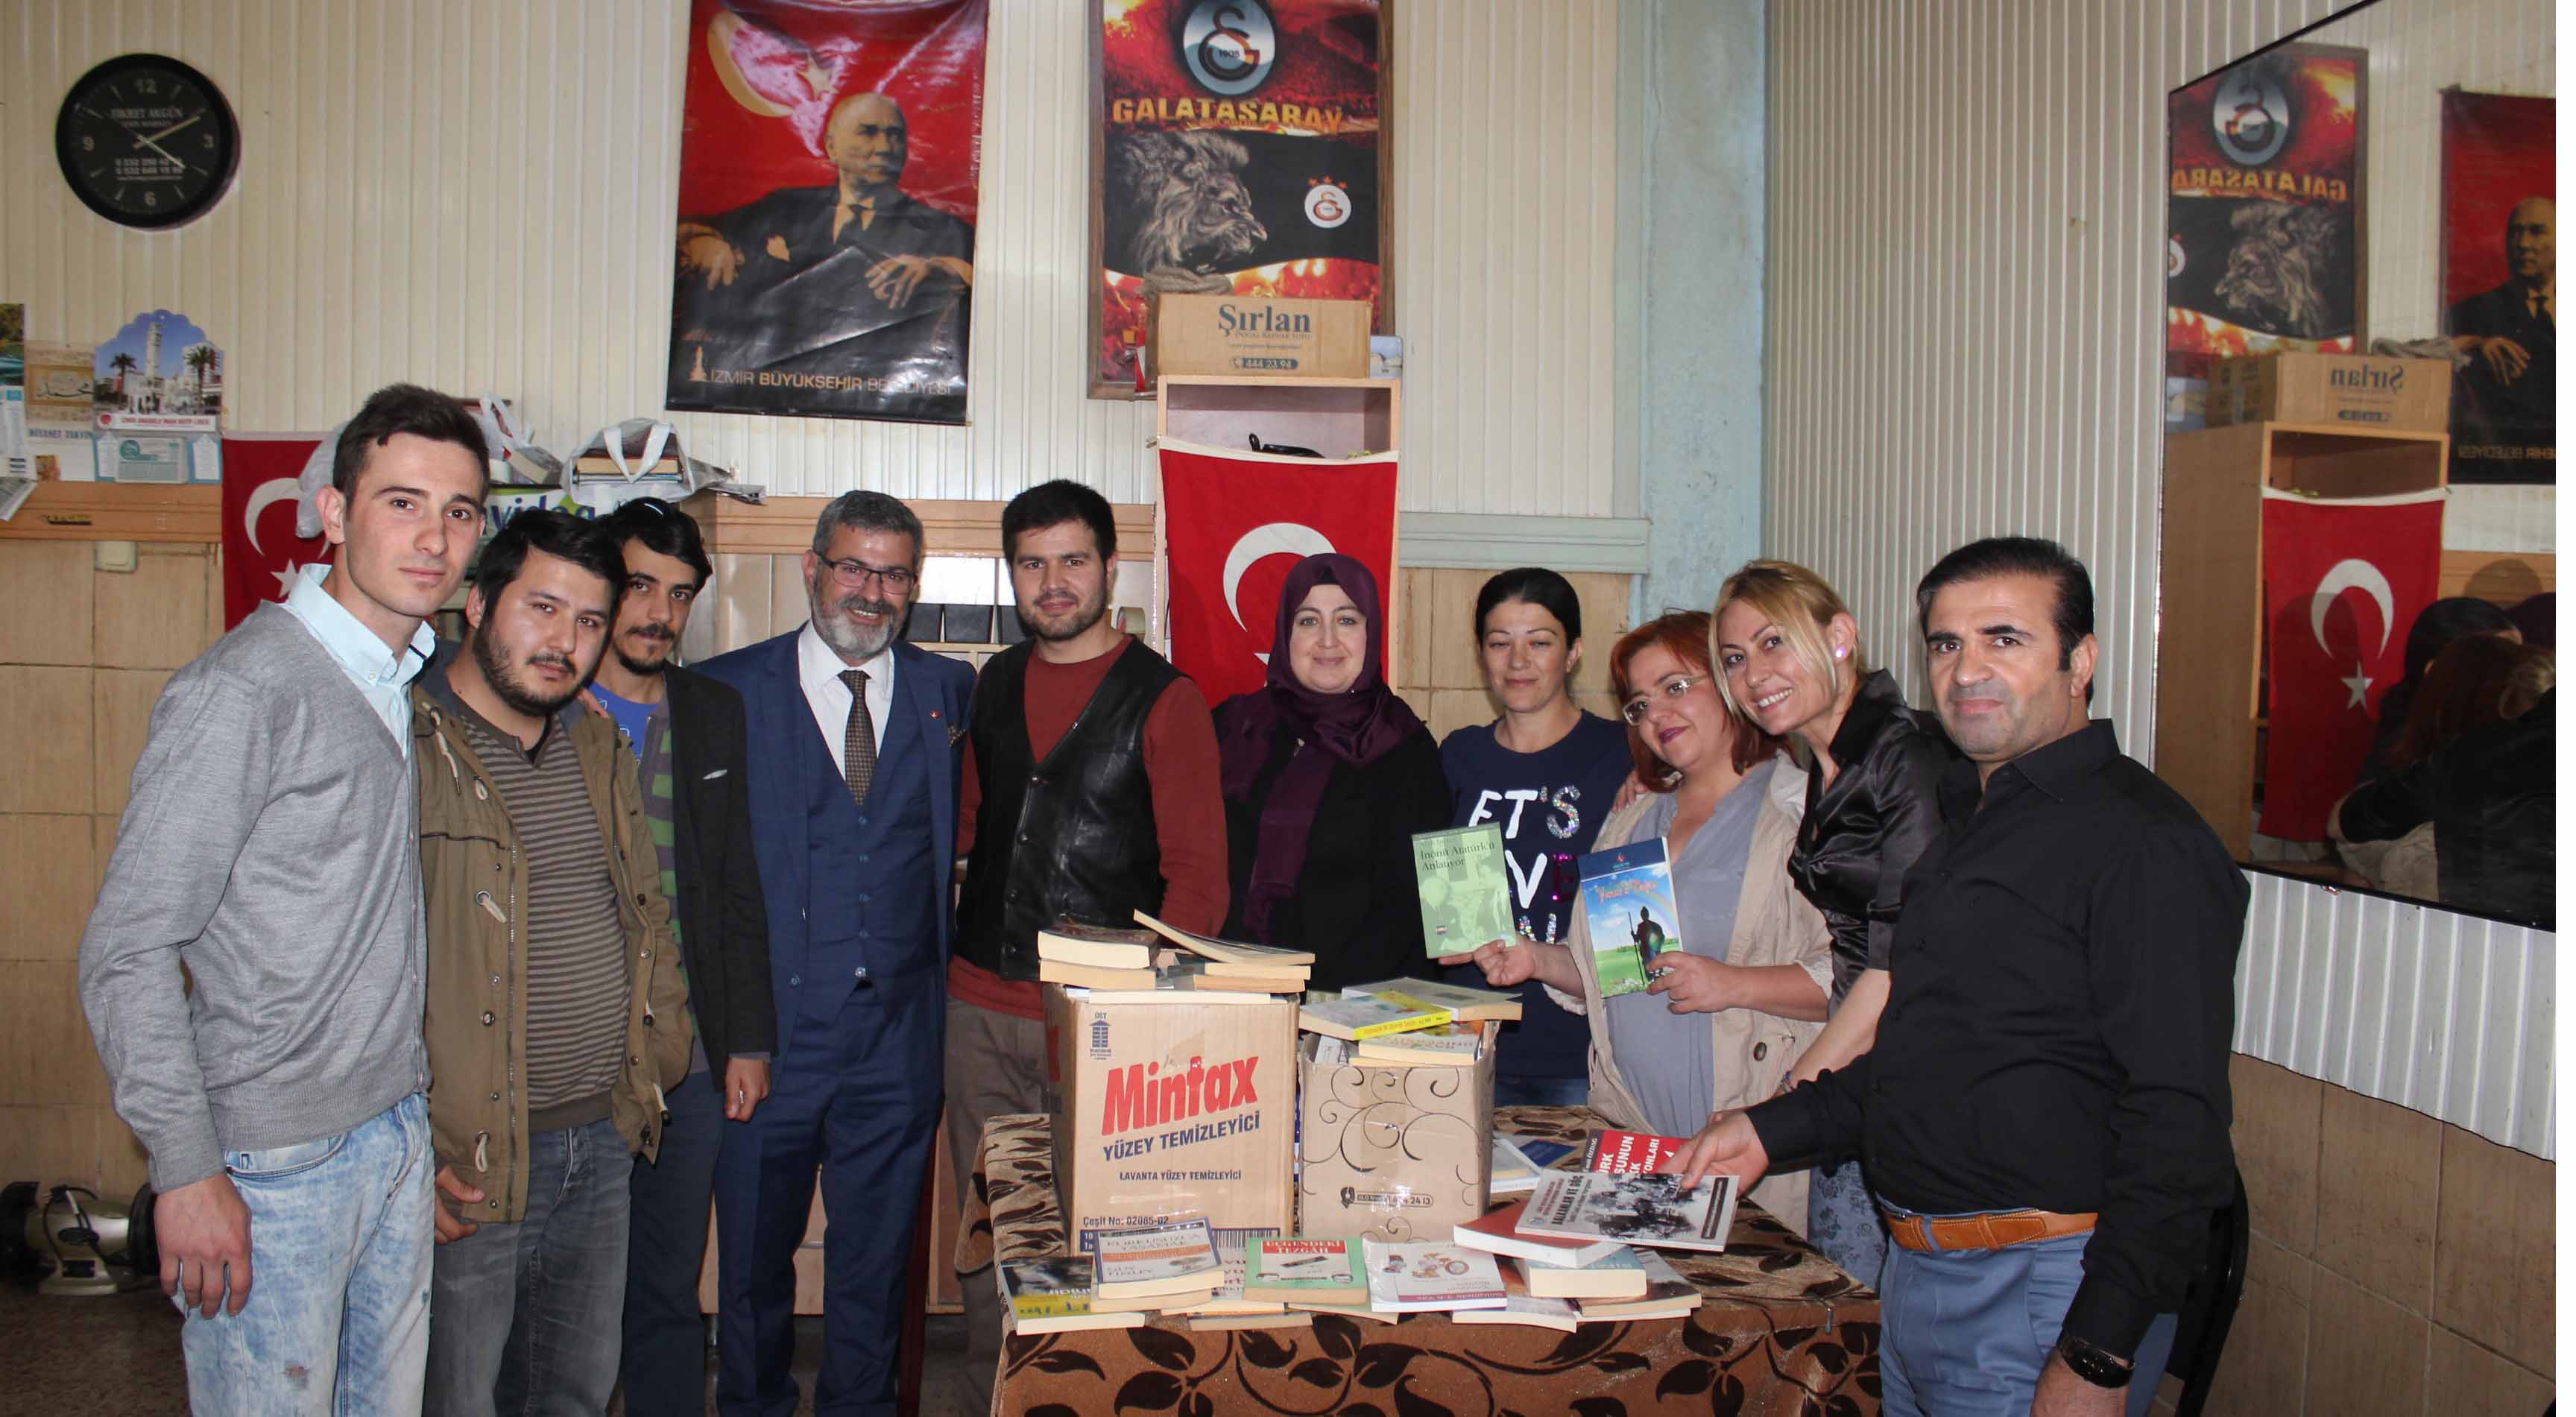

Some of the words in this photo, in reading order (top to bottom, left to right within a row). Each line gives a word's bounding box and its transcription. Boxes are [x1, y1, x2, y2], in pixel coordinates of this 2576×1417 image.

[1219, 48, 1240, 60] 1905
[136, 78, 157, 95] 12
[1113, 97, 1344, 135] GALATASARAY
[83, 136, 95, 152] 9
[202, 133, 214, 149] 3
[143, 192, 157, 206] 6
[1218, 303, 1311, 338] Şırlan
[1094, 1012, 1107, 1020] ÜST
[1102, 1055, 1260, 1136] Mintax
[1103, 1137, 1155, 1162] YÜZEY
[1159, 1110, 1260, 1150] TEMİZLEYİCİ
[1614, 1136, 1635, 1175] SUNUN
[1120, 1171, 1158, 1181] LAVANTA
[1161, 1170, 1187, 1181] YÜZEY
[1190, 1170, 1242, 1181] TEMİZLEYİCİ
[1083, 1216, 1107, 1227] Çeşit
[1108, 1216, 1124, 1225] No:
[1085, 1242, 1093, 1250] Ta
